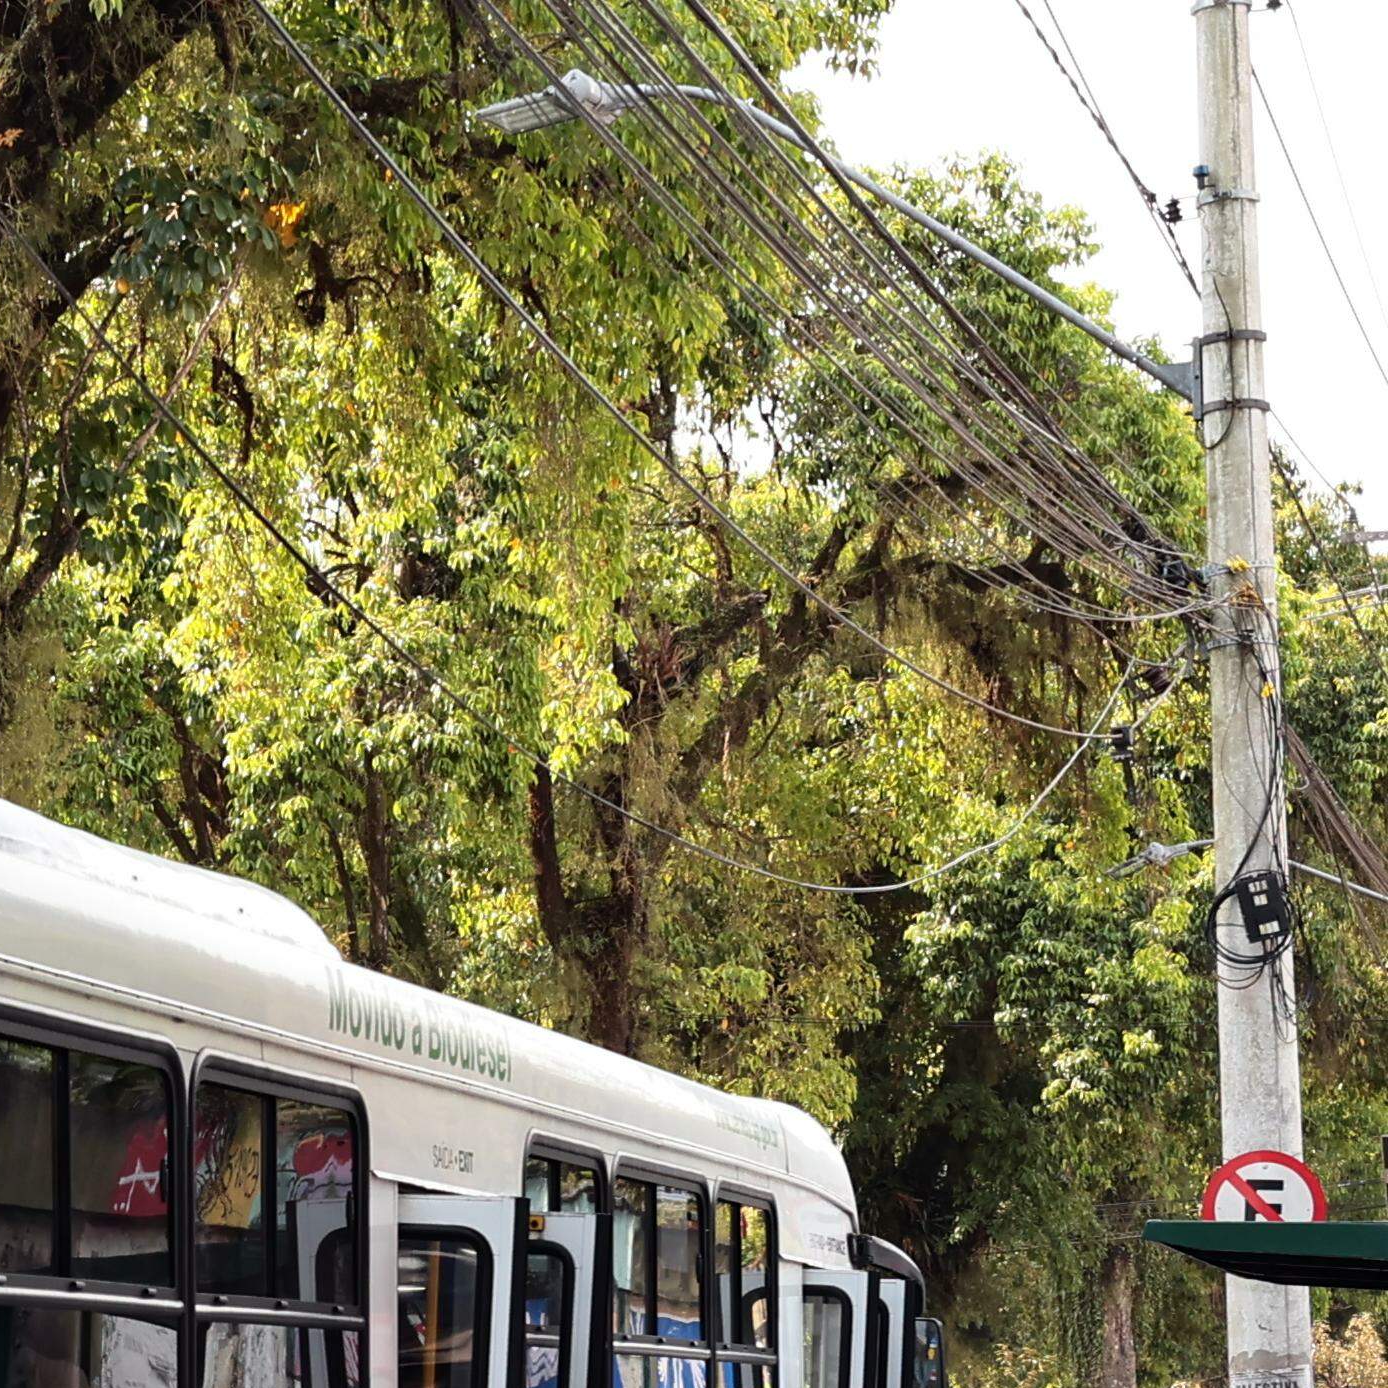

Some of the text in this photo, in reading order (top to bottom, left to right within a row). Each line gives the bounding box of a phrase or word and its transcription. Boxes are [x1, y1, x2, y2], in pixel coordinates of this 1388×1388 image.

[325, 964, 512, 1083] Movido a Biodiesel
